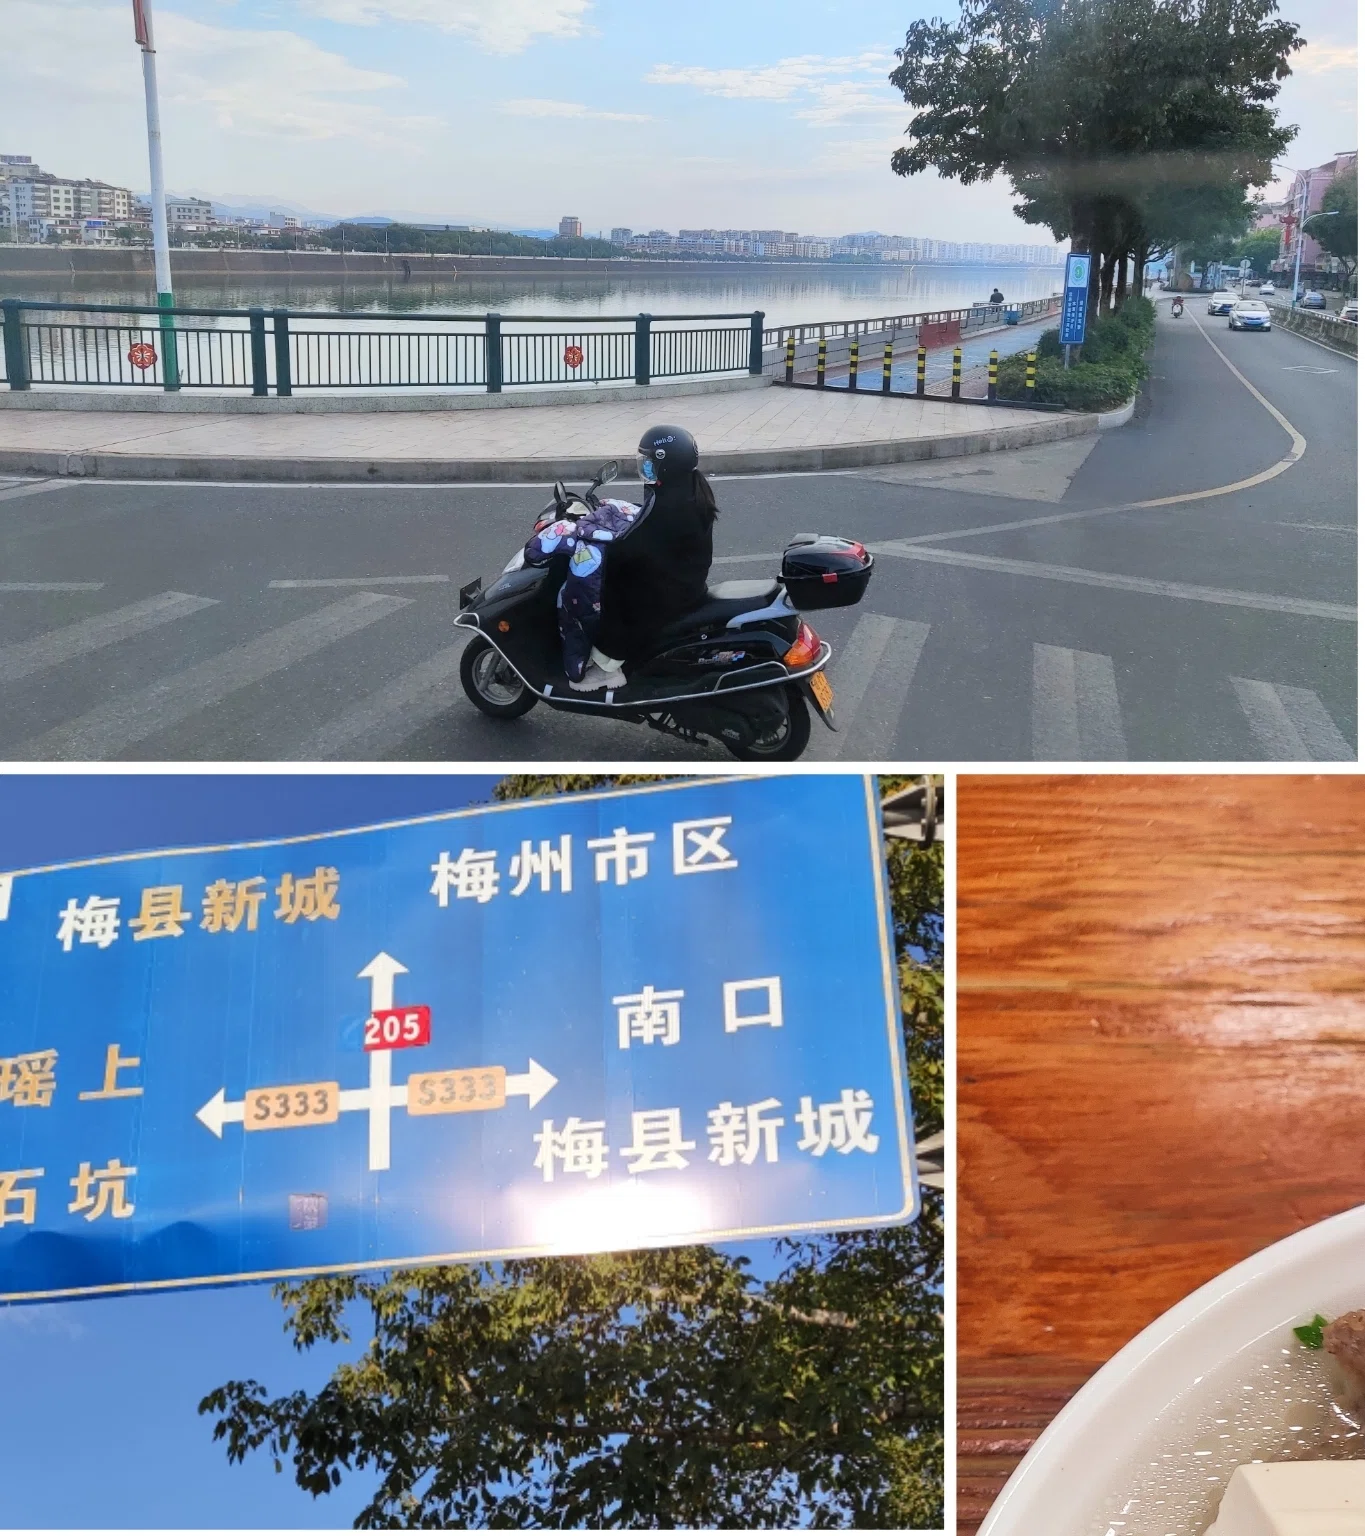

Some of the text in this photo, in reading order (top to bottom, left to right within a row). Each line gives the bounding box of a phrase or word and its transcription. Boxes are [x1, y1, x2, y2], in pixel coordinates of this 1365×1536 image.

[430, 815, 739, 908] 梅州市区
[56, 865, 342, 953] 梅县新城
[612, 976, 784, 1050] 南口
[0, 1043, 145, 1108] 瑶上
[253, 1088, 330, 1121] S333
[417, 1073, 497, 1107] S333
[533, 1089, 880, 1183] 梅县新城
[0, 1158, 138, 1229] 石坑
